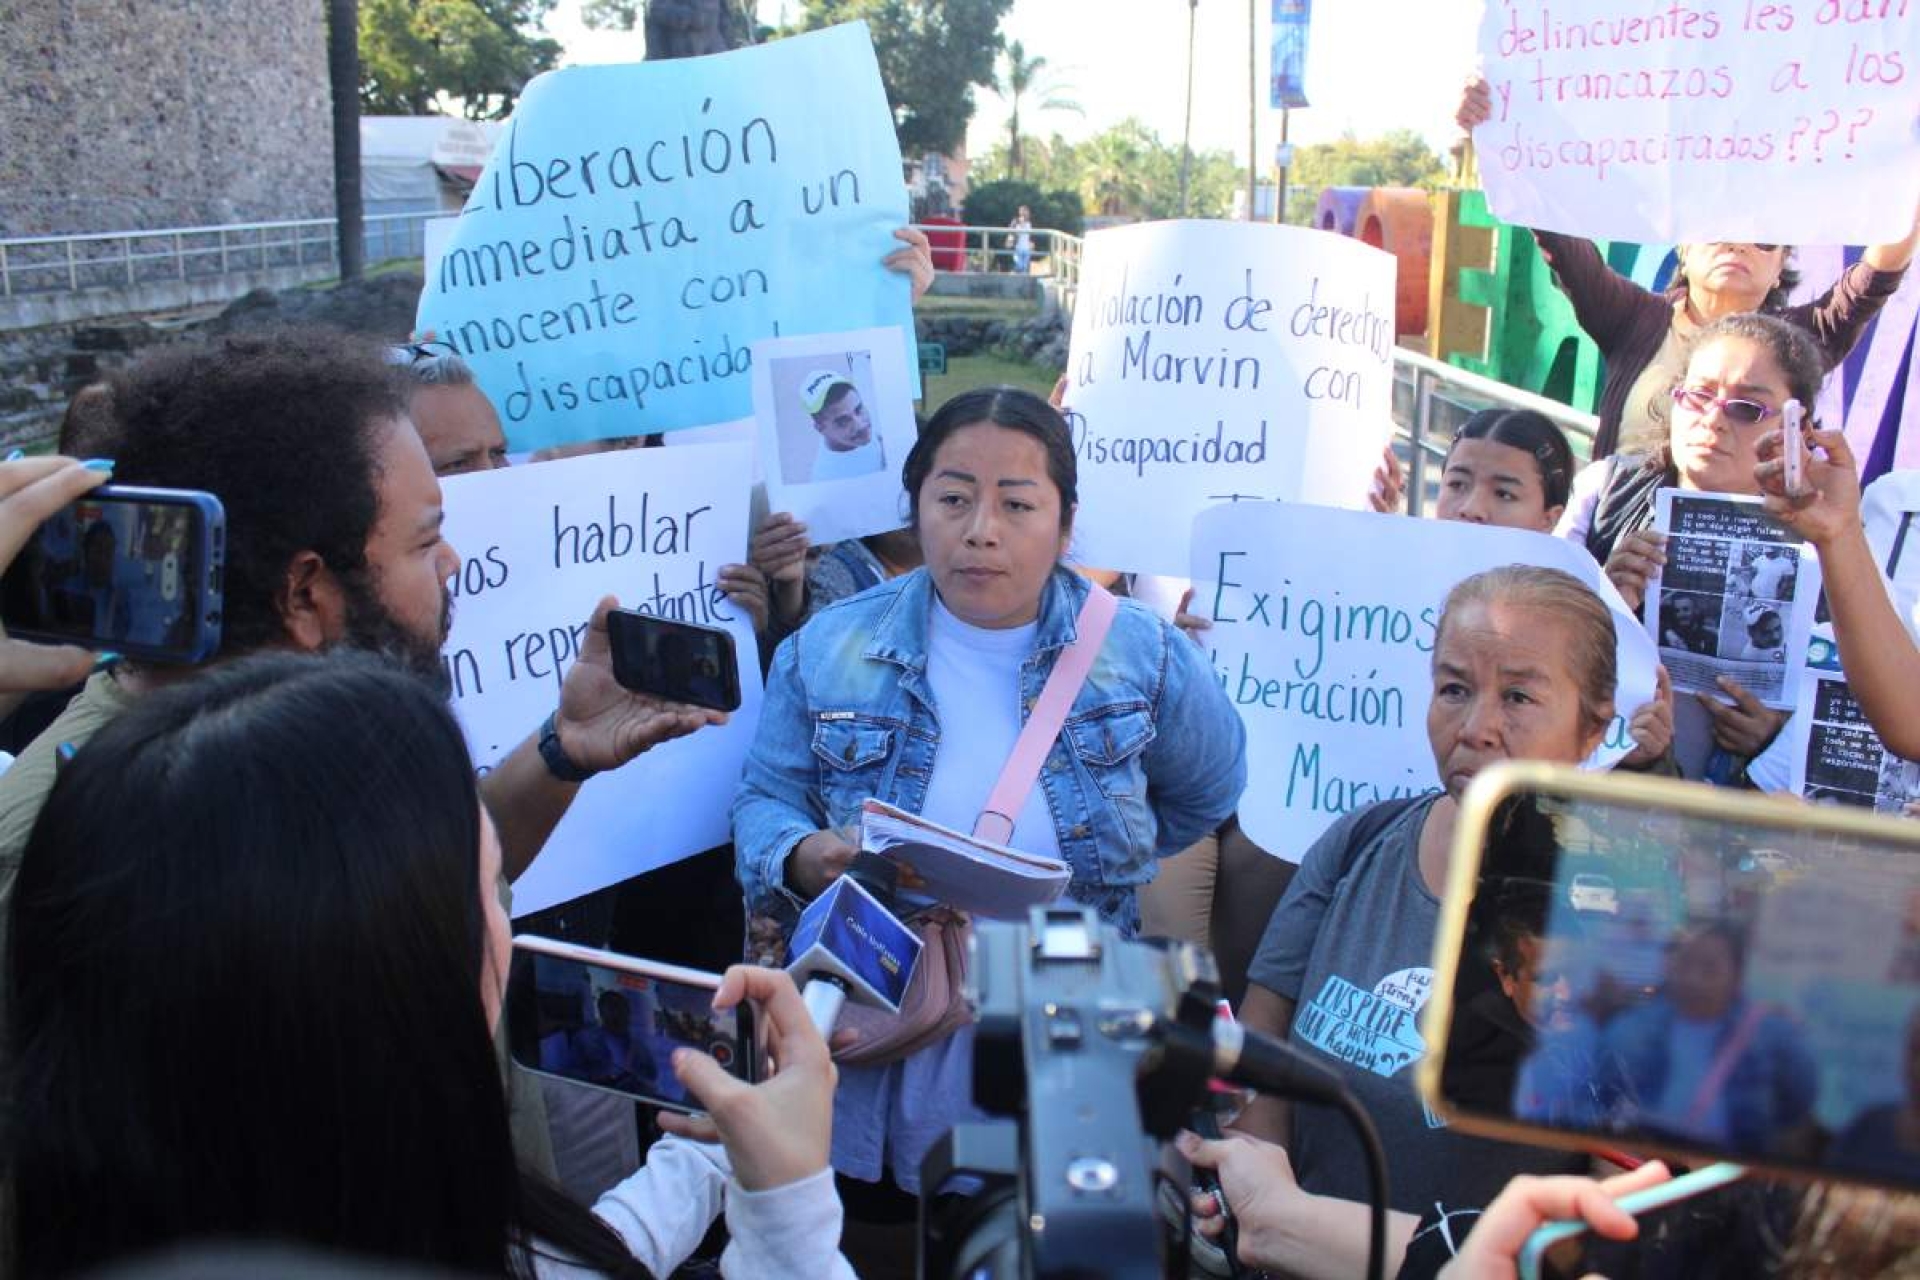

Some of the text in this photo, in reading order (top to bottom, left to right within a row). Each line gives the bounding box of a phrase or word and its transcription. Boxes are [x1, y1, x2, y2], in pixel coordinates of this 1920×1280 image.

[1500, 0, 1721, 58] delincuentes
[1743, 0, 1795, 32] les
[1495, 43, 1905, 122] y trancazos a los
[463, 97, 778, 214] iberación
[440, 168, 860, 294] inmediata a un
[444, 268, 769, 357] inocente con
[1224, 268, 1272, 332] de
[1290, 277, 1392, 364] derechos
[504, 321, 781, 423] discapacida
[1078, 330, 1362, 410] a Marvin con
[1061, 408, 1267, 478] Discapacidad
[554, 492, 712, 569] hablar
[1212, 551, 1438, 680] Exigimos
[1316, 978, 1411, 1038] INSPIRE
